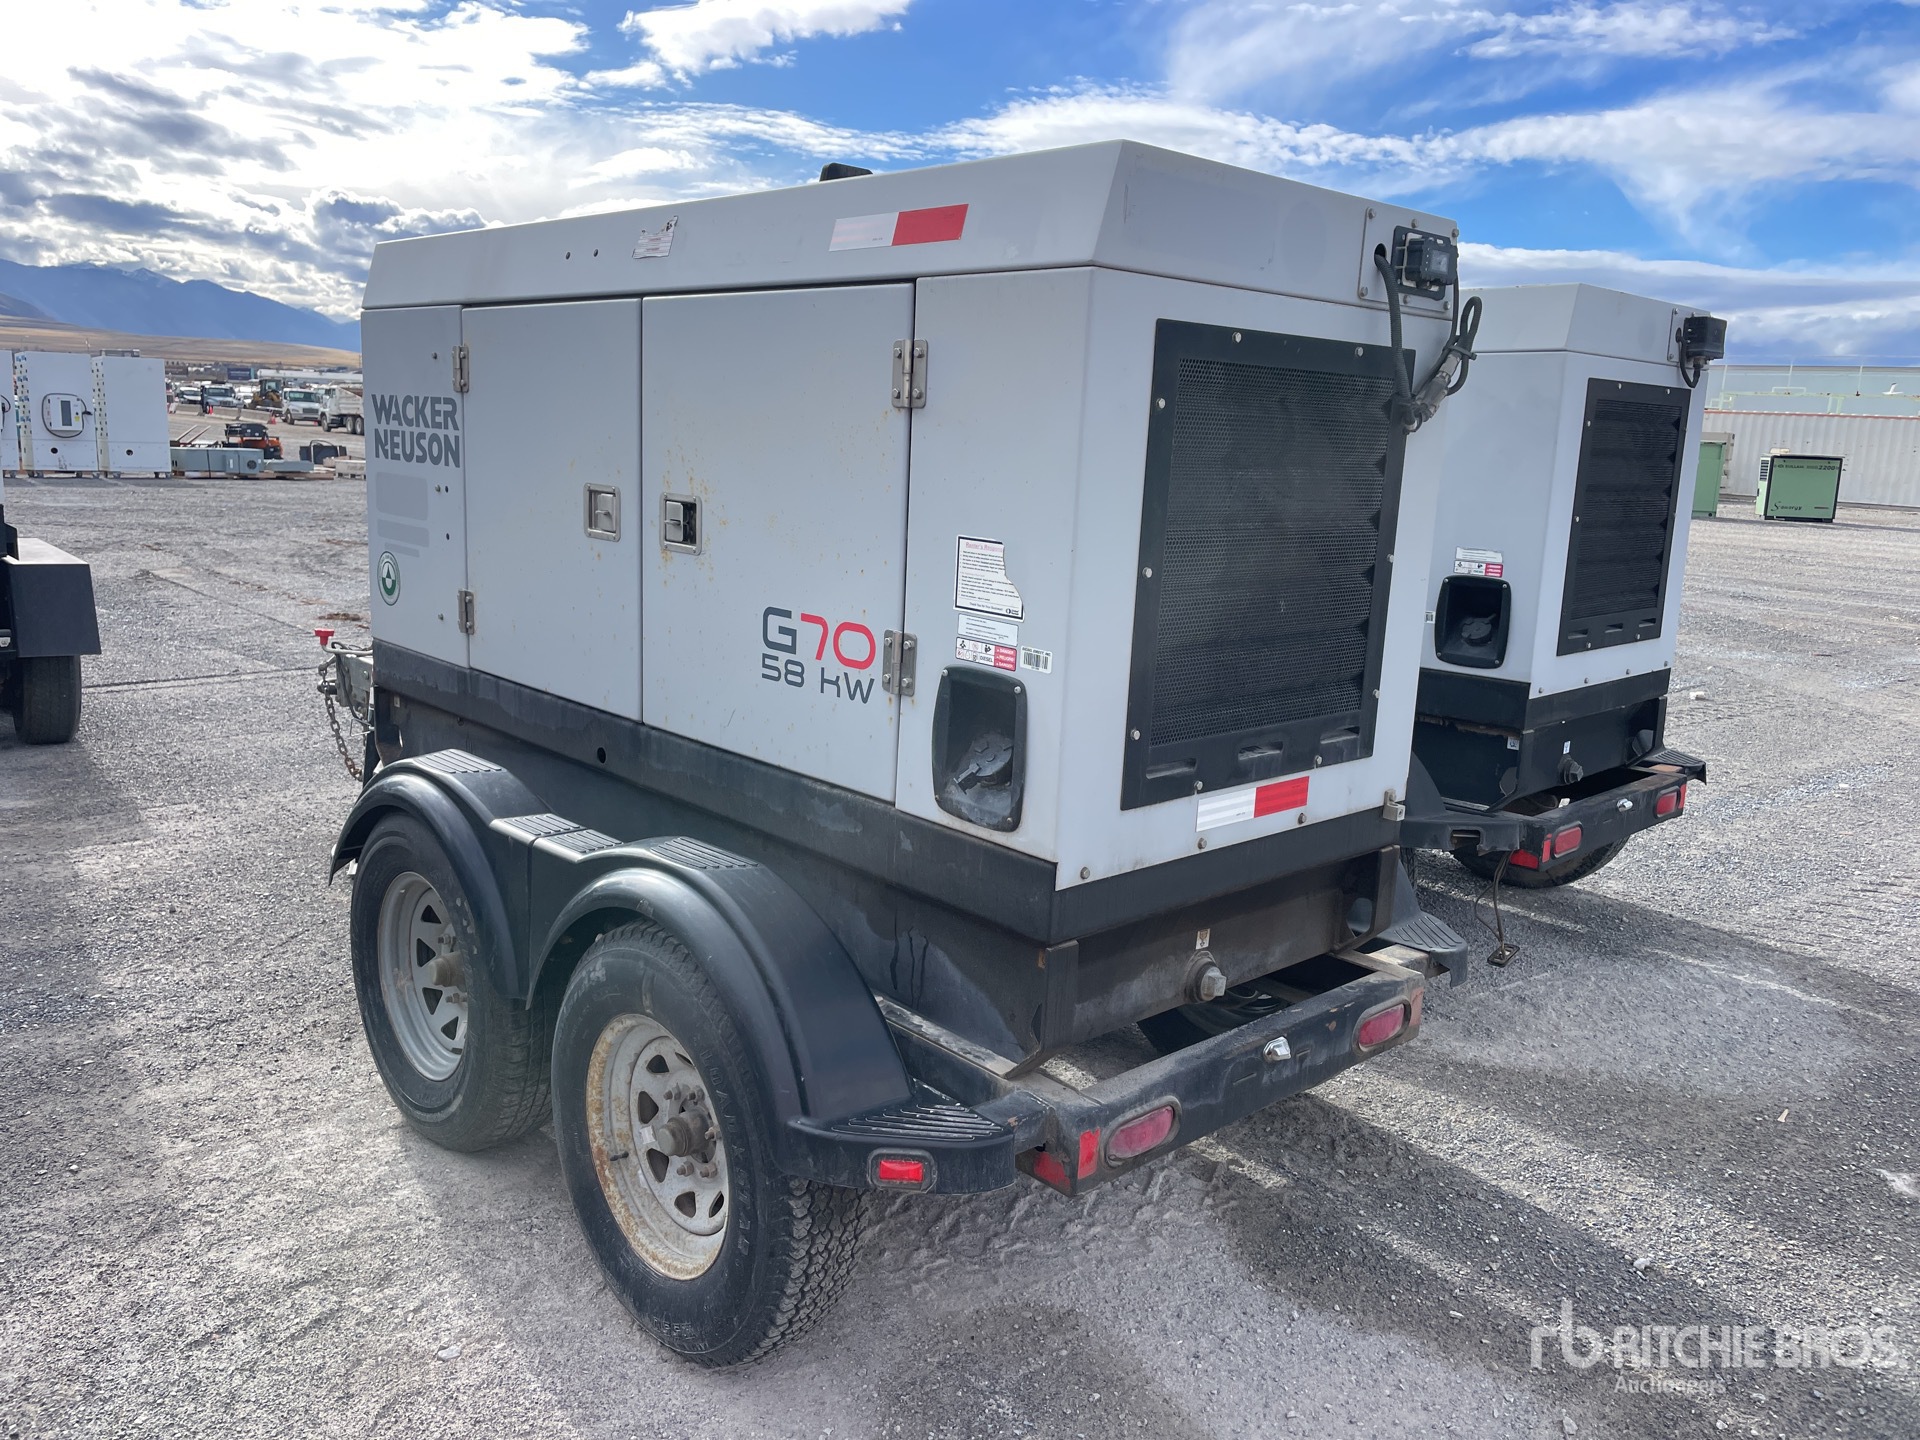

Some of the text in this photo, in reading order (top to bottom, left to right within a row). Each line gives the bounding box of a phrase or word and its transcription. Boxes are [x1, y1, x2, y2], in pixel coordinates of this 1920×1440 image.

[371, 394, 460, 431] WACKER
[374, 428, 461, 468] NEUSON
[762, 606, 877, 670] G70
[761, 652, 805, 688] 58
[979, 655, 993, 663] DIESEL
